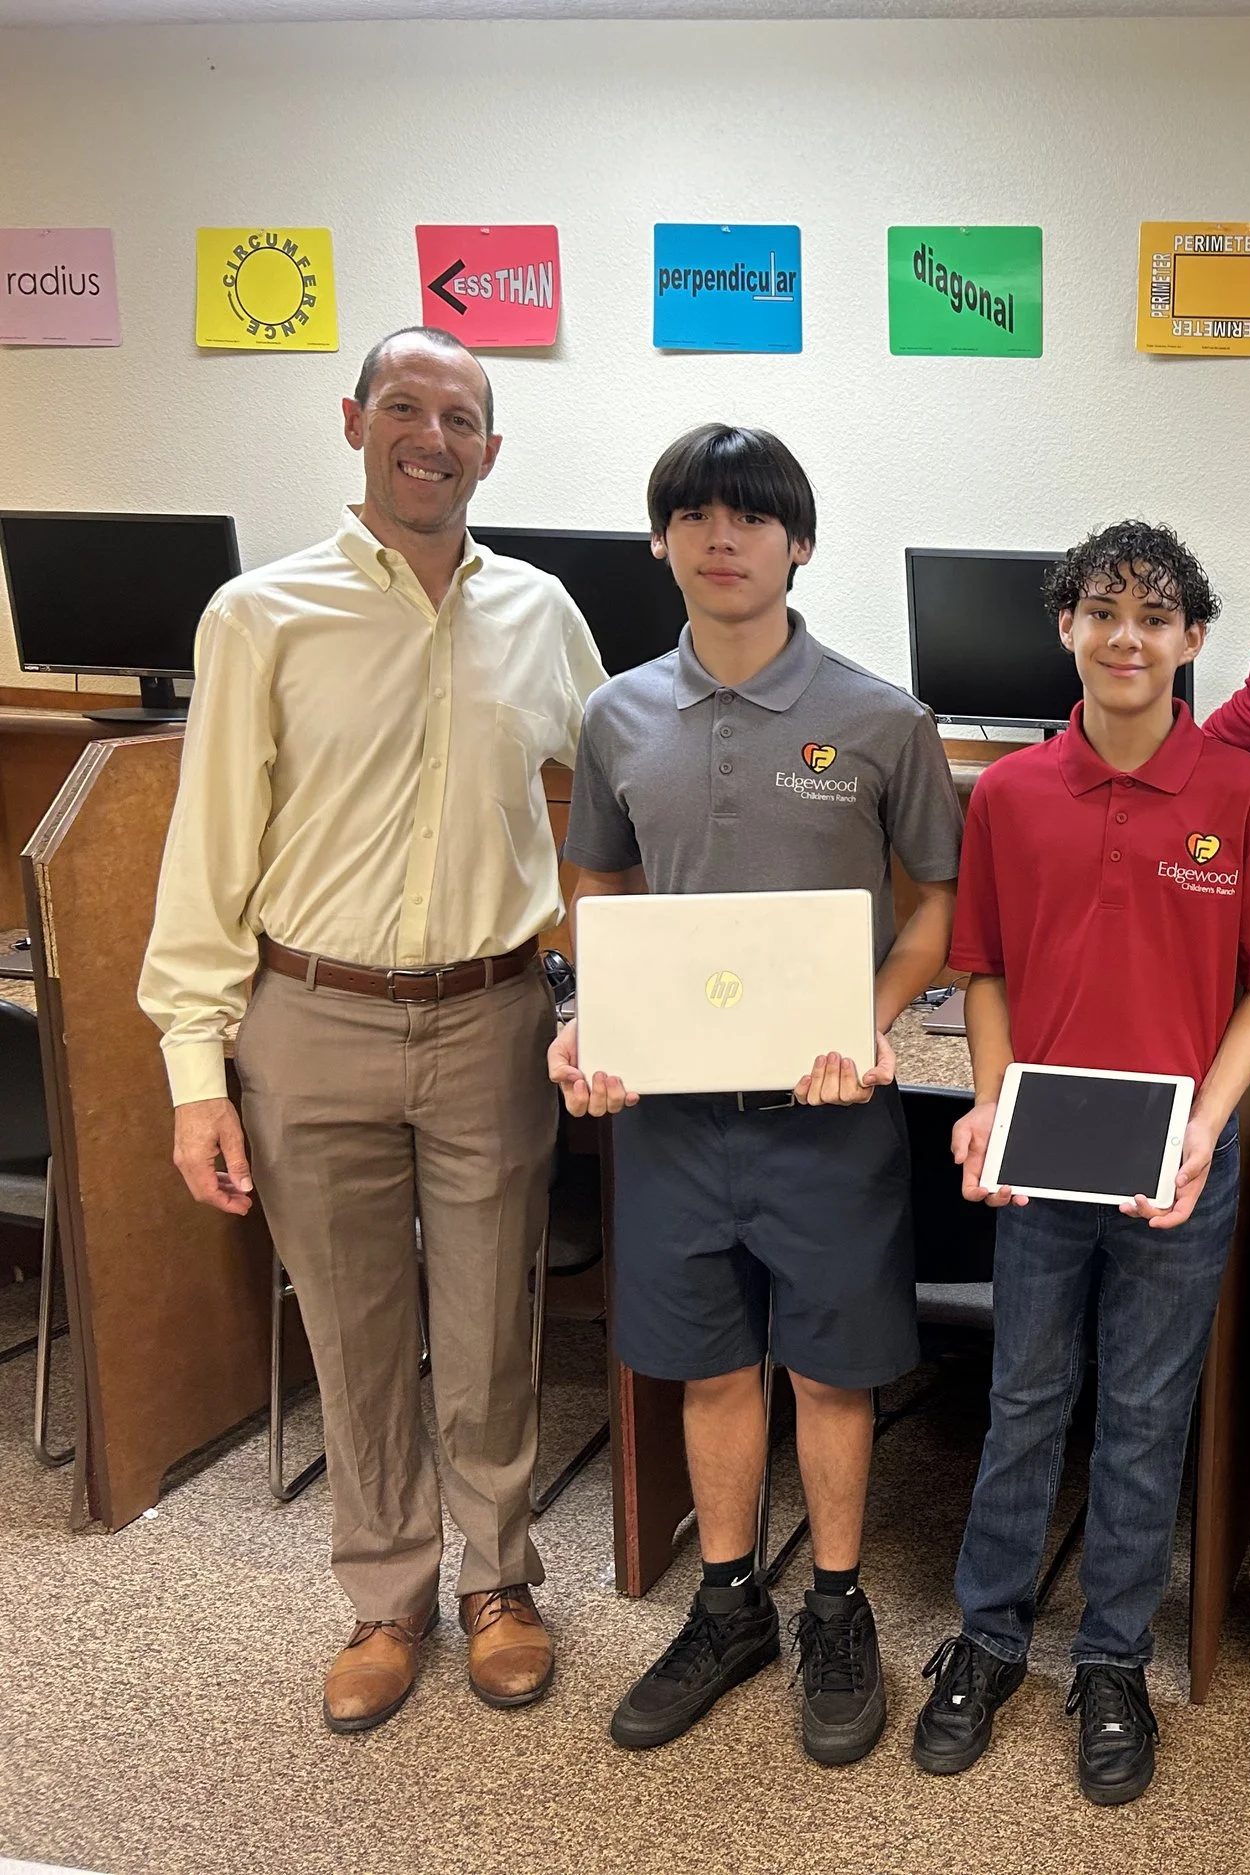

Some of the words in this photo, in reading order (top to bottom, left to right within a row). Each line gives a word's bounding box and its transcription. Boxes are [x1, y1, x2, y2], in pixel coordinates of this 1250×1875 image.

[7, 264, 100, 297] radius
[222, 232, 317, 340] CIRCUMFERENCE
[494, 260, 554, 309] THAN
[658, 250, 796, 298] perpendicular
[913, 242, 1014, 334] diagonal
[1150, 252, 1172, 318] PERIMETER
[775, 771, 858, 793] Edgewood
[800, 791, 835, 802] Children's
[835, 793, 857, 803] Ranch
[1157, 860, 1239, 885] Edgewood
[1181, 882, 1215, 894] Children's
[1215, 886, 1236, 896] Ranch
[709, 970, 741, 1008] hp
